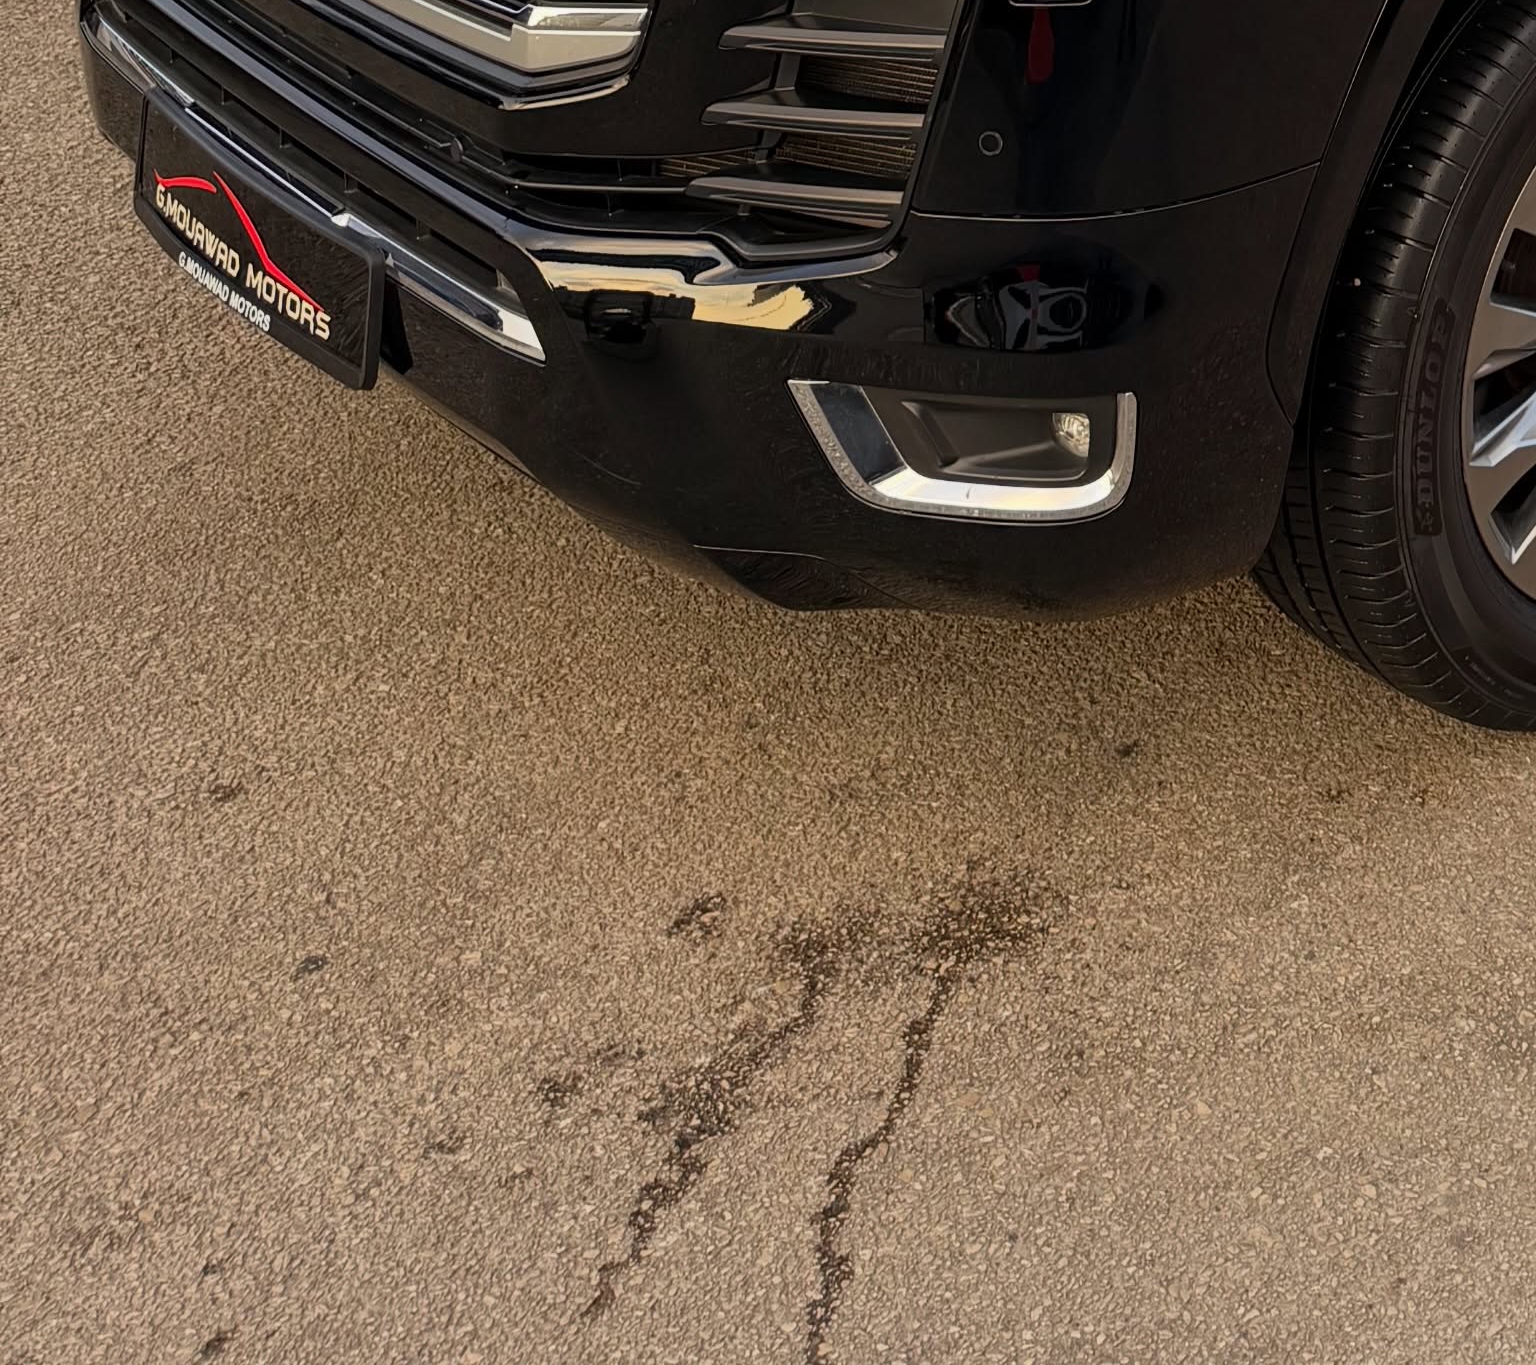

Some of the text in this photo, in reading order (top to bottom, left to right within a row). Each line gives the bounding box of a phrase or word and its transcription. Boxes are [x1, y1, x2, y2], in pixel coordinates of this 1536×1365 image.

[155, 183, 332, 341] G.MOUAWAD MOTORS
[178, 251, 271, 332] G.MOUAWAD MOTORS
